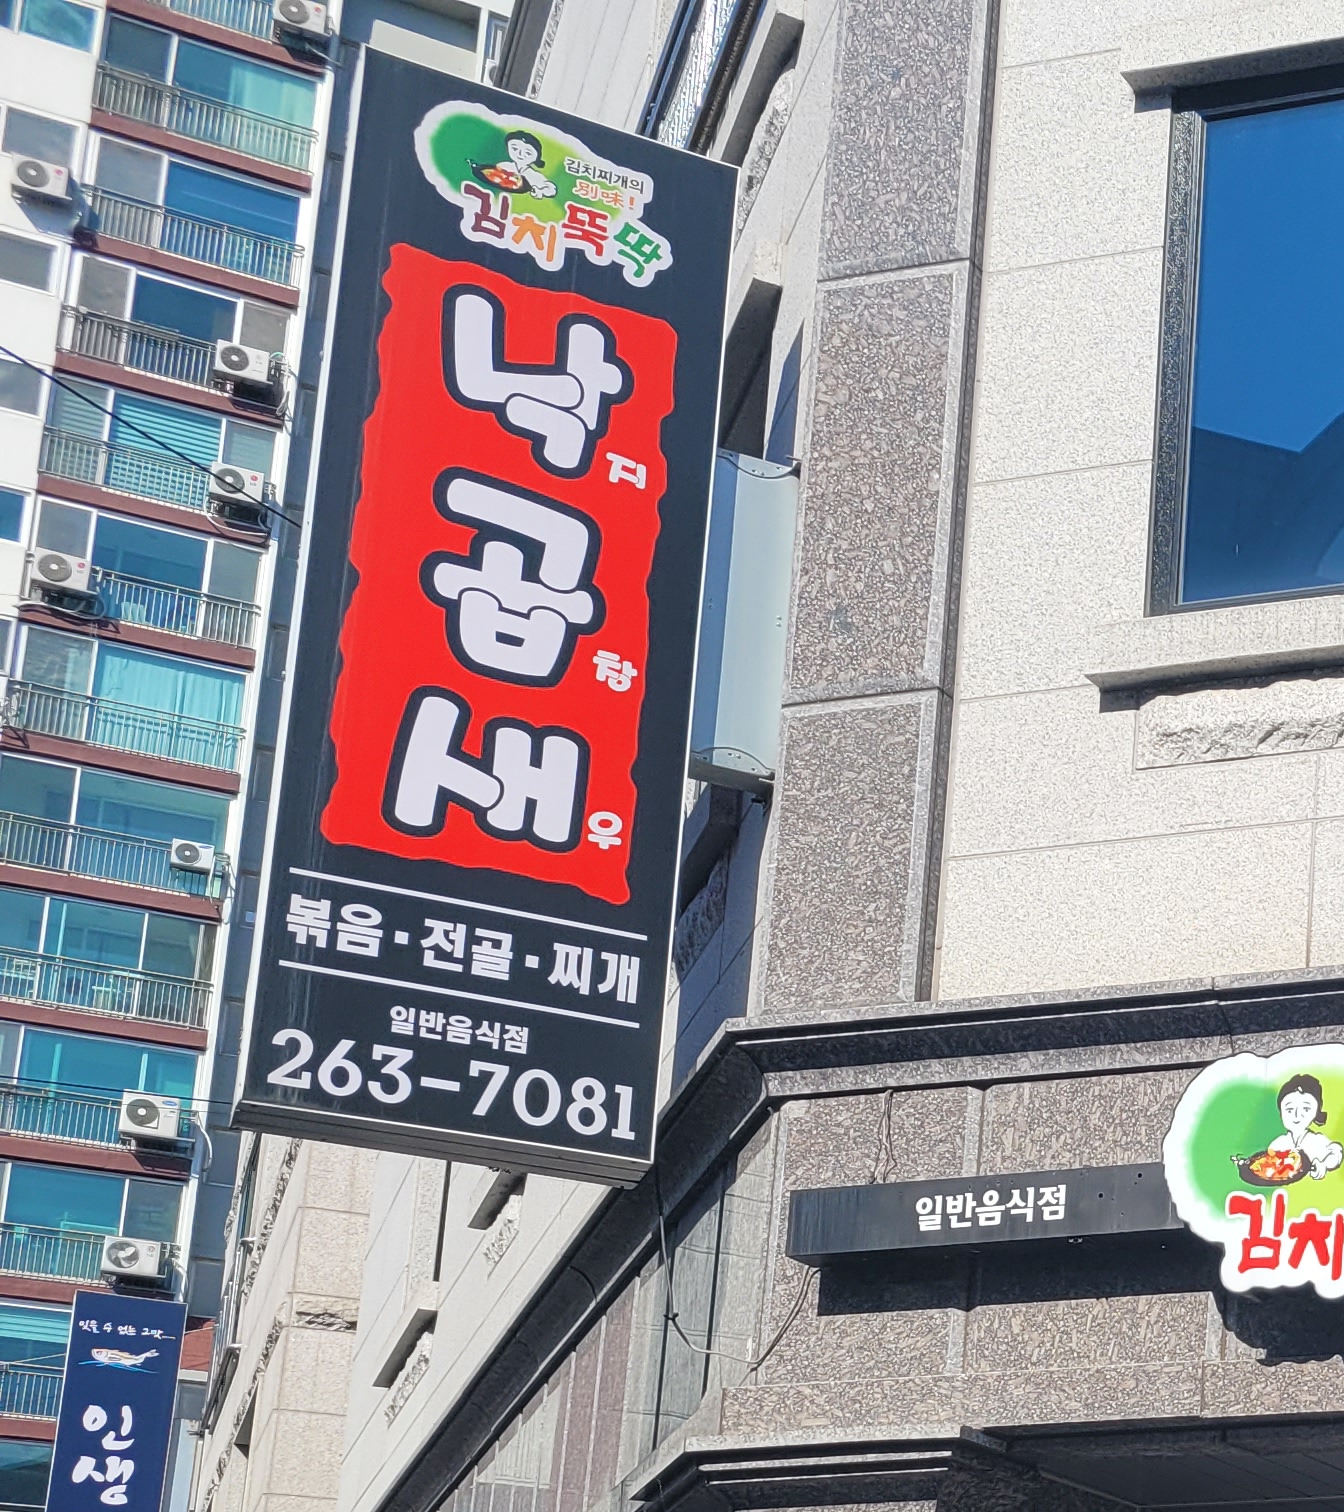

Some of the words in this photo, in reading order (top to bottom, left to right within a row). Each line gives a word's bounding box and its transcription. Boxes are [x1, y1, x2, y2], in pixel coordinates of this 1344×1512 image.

[566, 159, 644, 194] 김치찌개의
[464, 184, 663, 278] 김치뚝딱
[389, 1005, 529, 1055] 일반음식점
[267, 1028, 635, 1140] 263-7081
[915, 1184, 1067, 1232] 일반음식점
